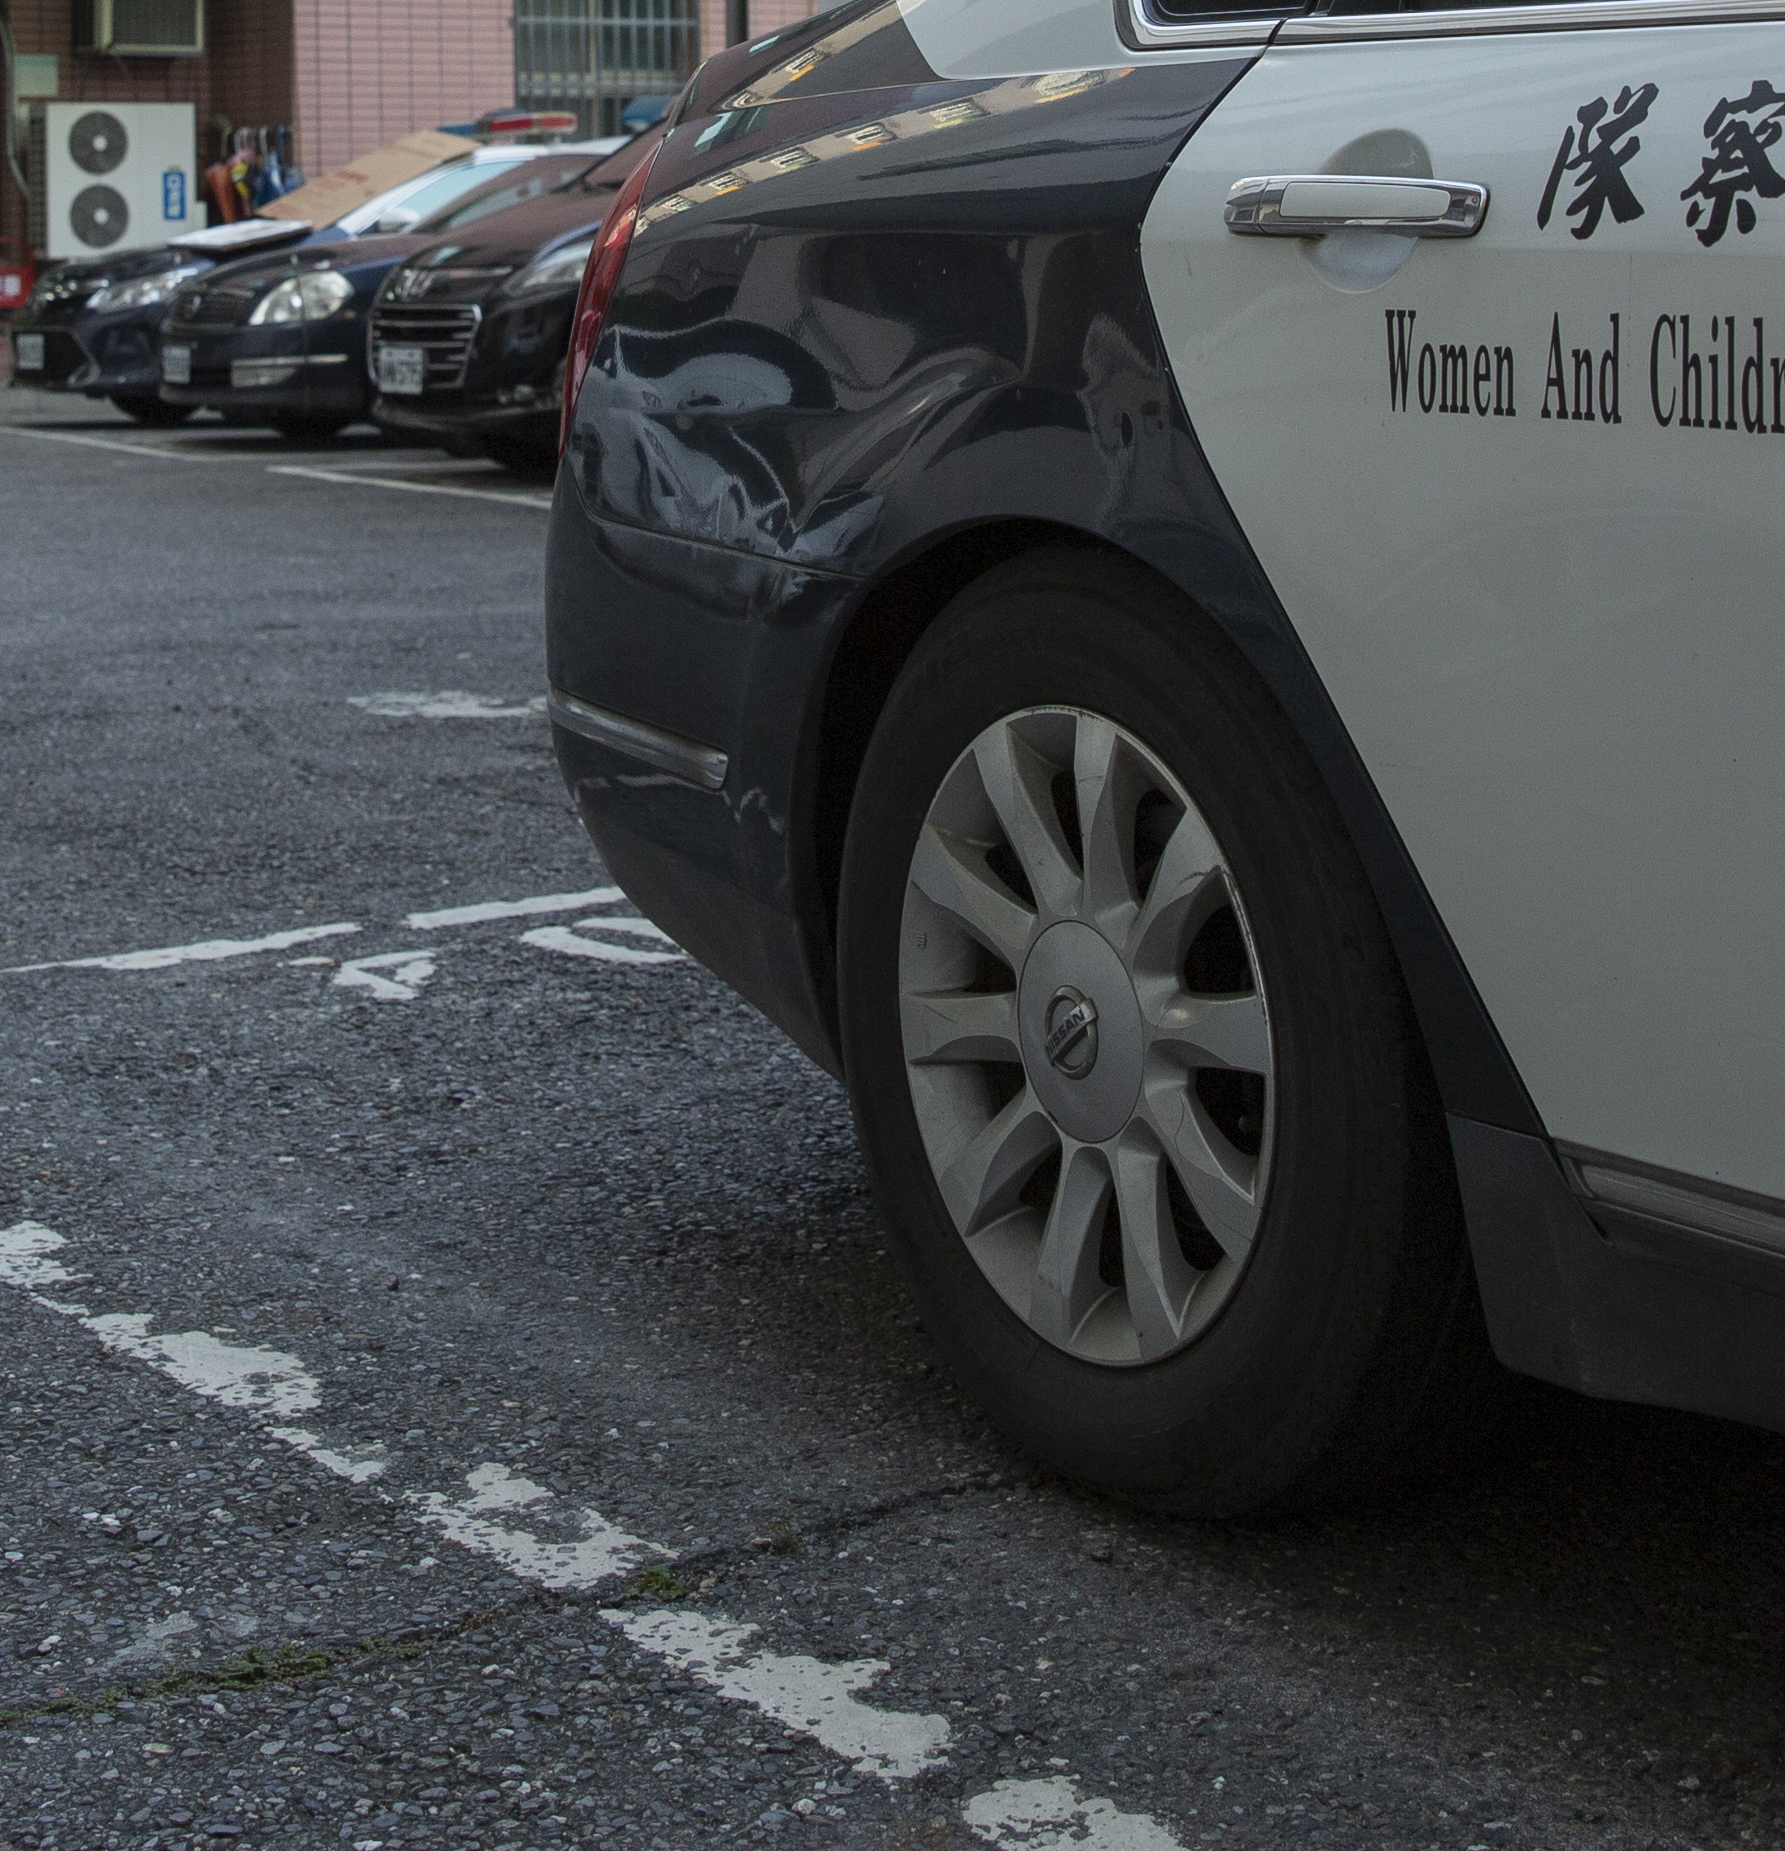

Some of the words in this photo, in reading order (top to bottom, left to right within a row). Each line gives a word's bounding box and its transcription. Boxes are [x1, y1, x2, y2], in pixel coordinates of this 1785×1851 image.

[1384, 309, 1516, 418] Women
[1541, 312, 1622, 425] And
[1044, 1006, 1086, 1057] NISSAN
